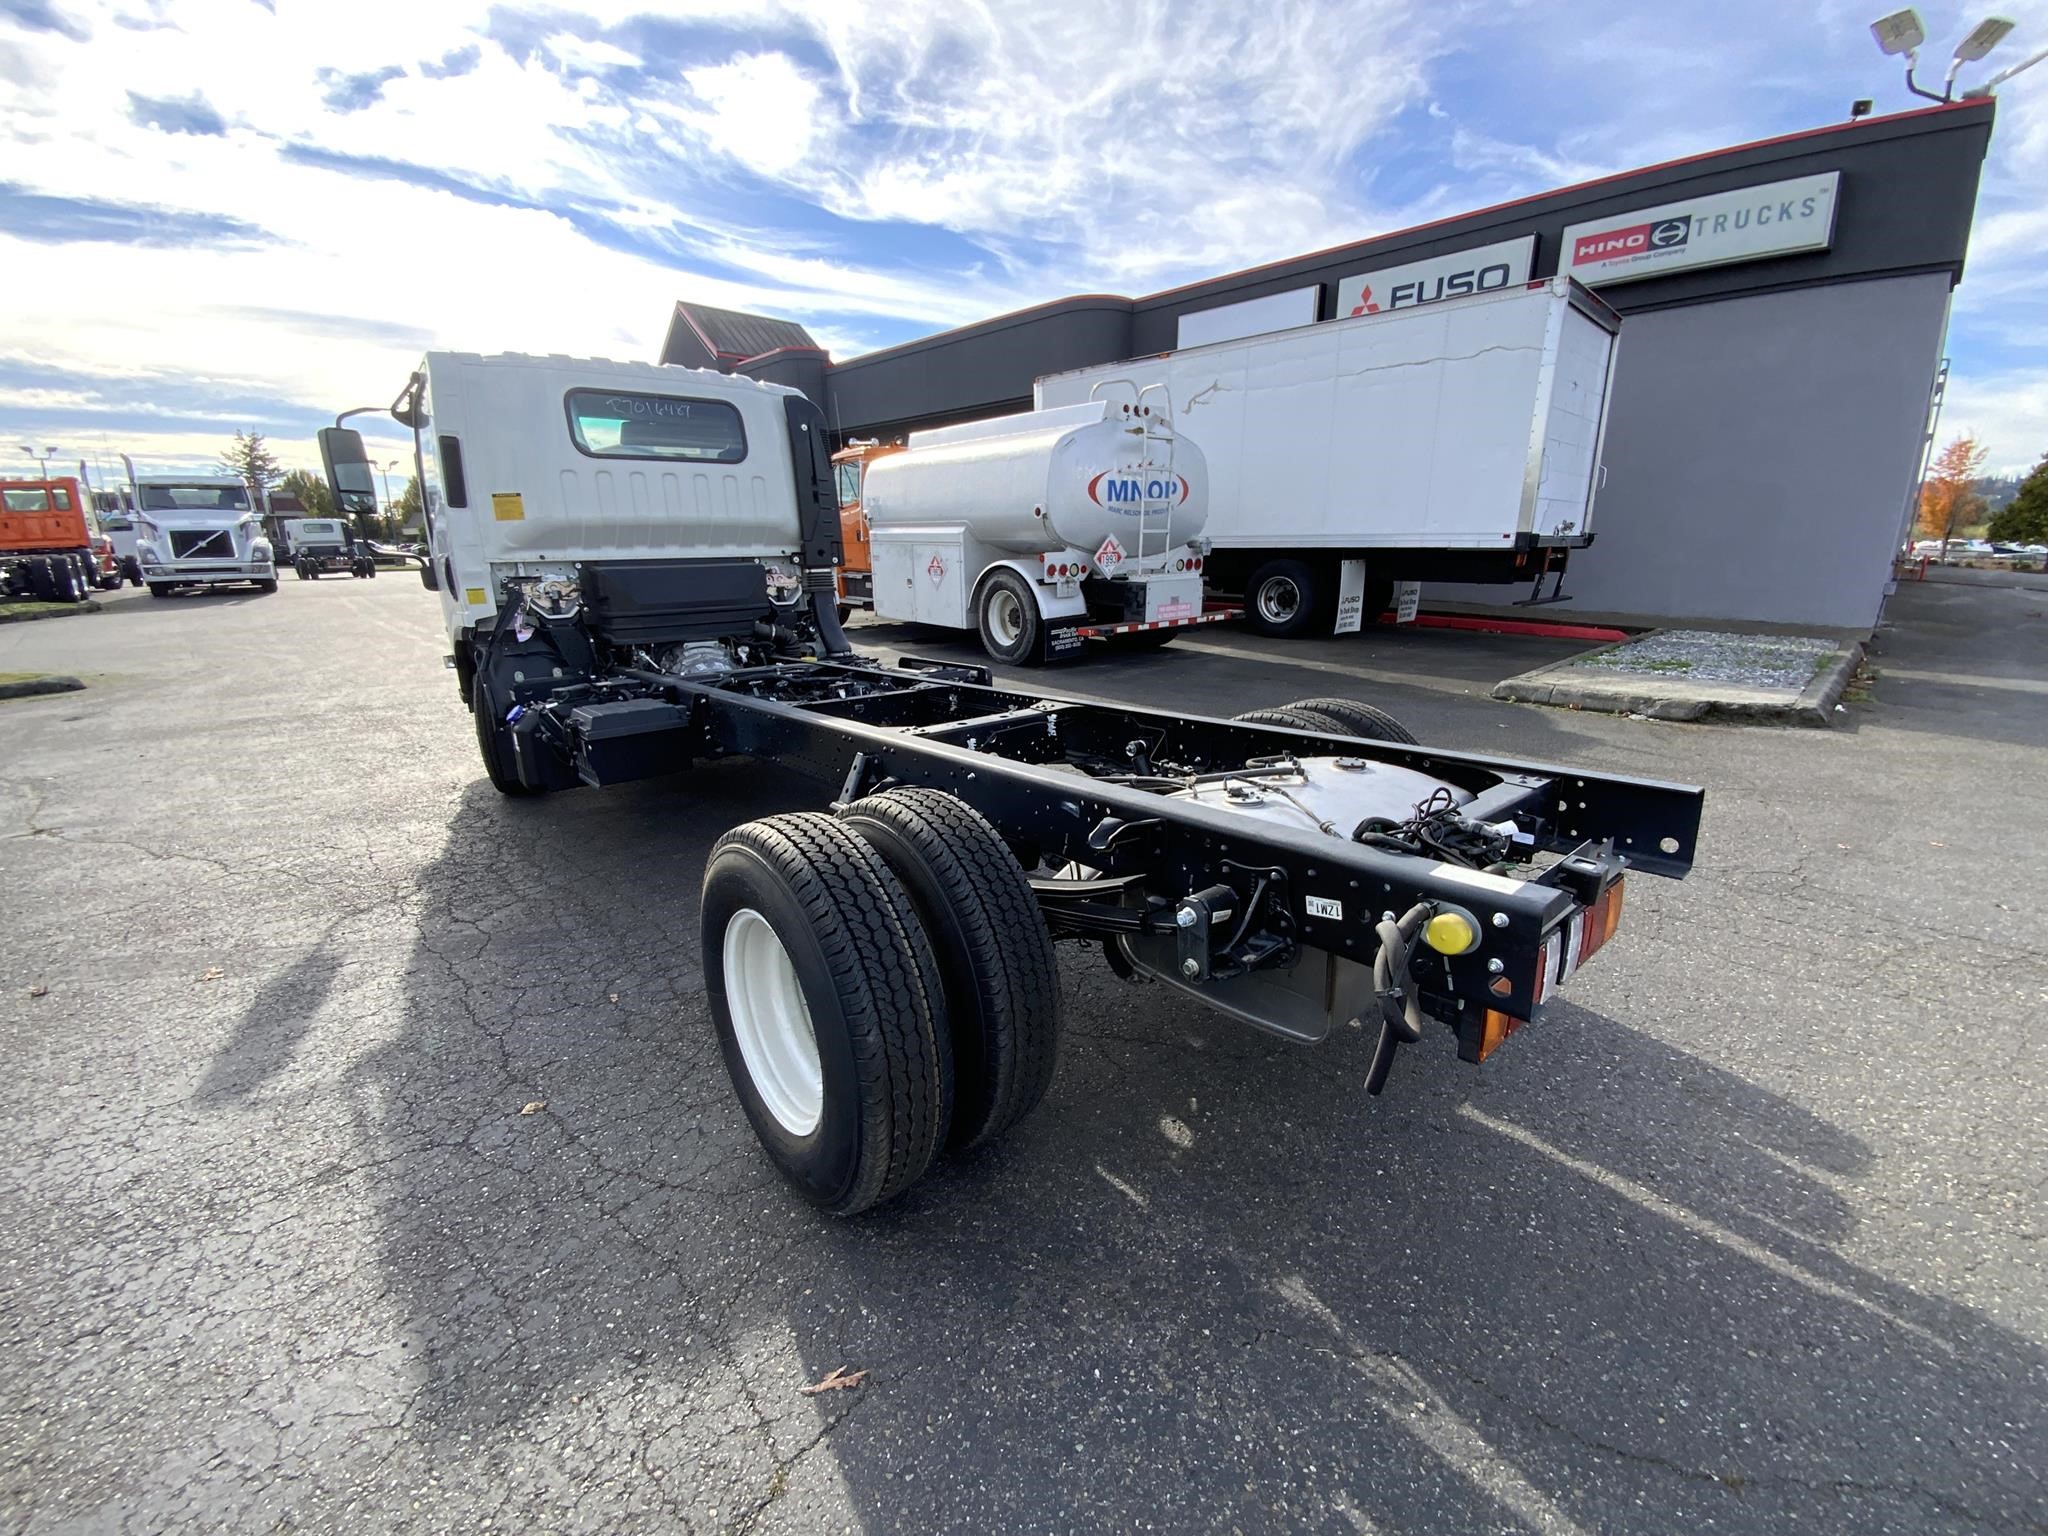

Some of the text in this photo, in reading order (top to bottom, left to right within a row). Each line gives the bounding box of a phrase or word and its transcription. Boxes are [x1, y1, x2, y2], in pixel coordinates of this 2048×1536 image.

[1579, 234, 1645, 256] HINO
[1695, 197, 1815, 237] TRUCKS
[1653, 247, 1686, 259] Company
[1390, 263, 1510, 308] FUSO
[1107, 479, 1177, 502] MNOP
[1103, 554, 1117, 565] 1993
